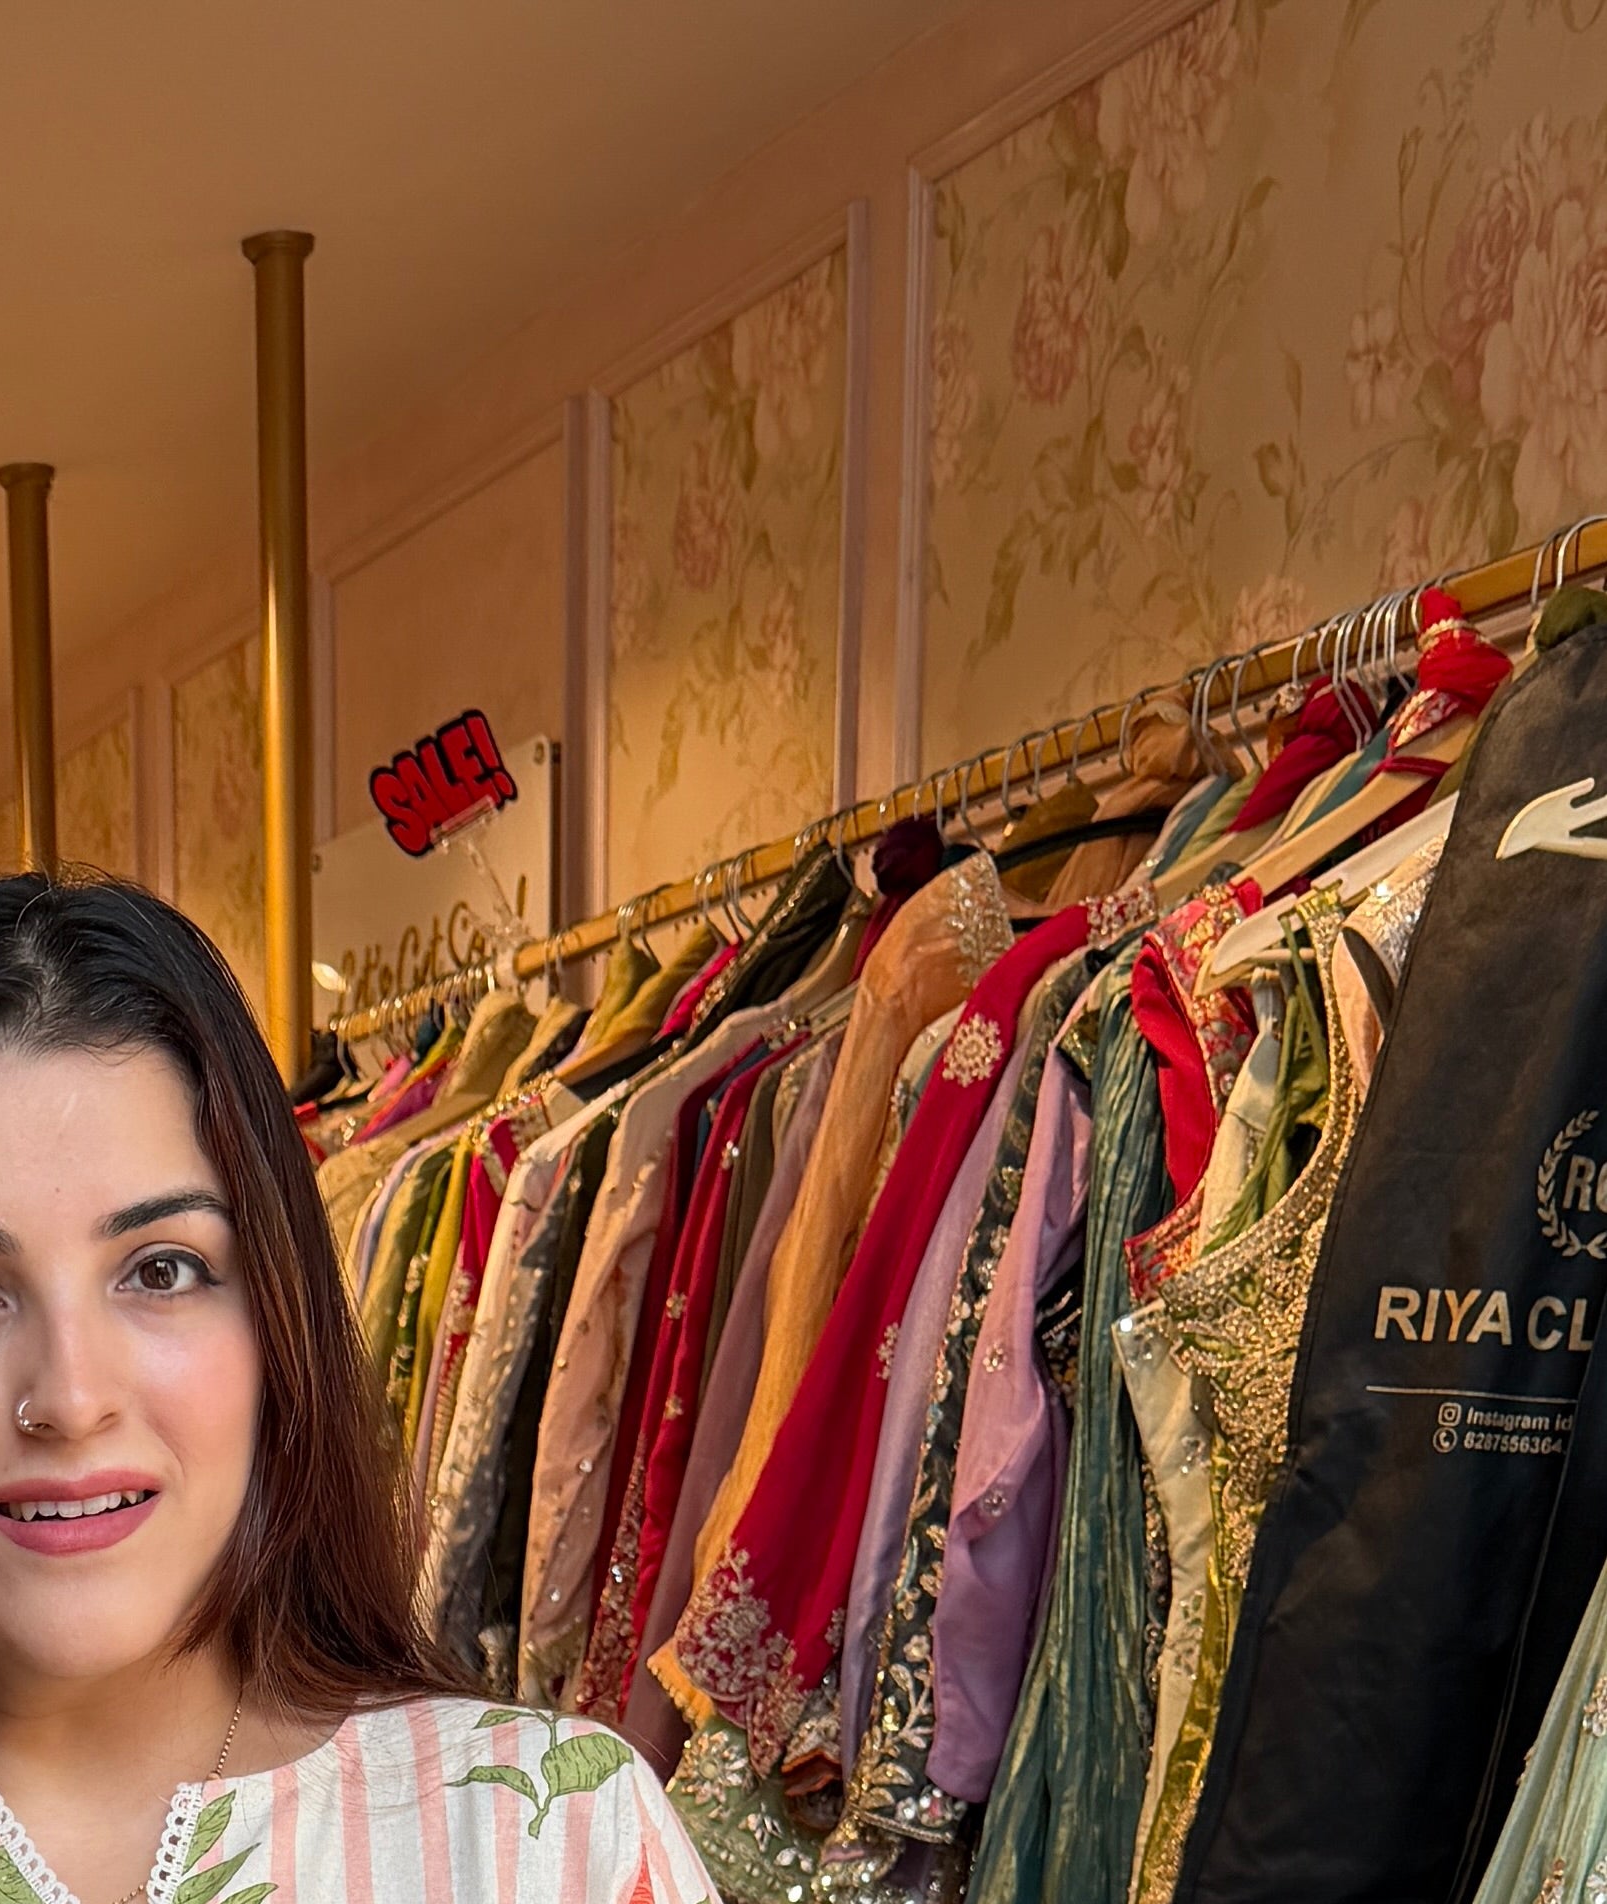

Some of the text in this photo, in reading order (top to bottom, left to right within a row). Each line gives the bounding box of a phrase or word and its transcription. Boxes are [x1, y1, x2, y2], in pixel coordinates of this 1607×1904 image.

[370, 710, 517, 856] SALE!
[1374, 1285, 1513, 1346] RIYA
[1466, 1406, 1550, 1432] Instagram
